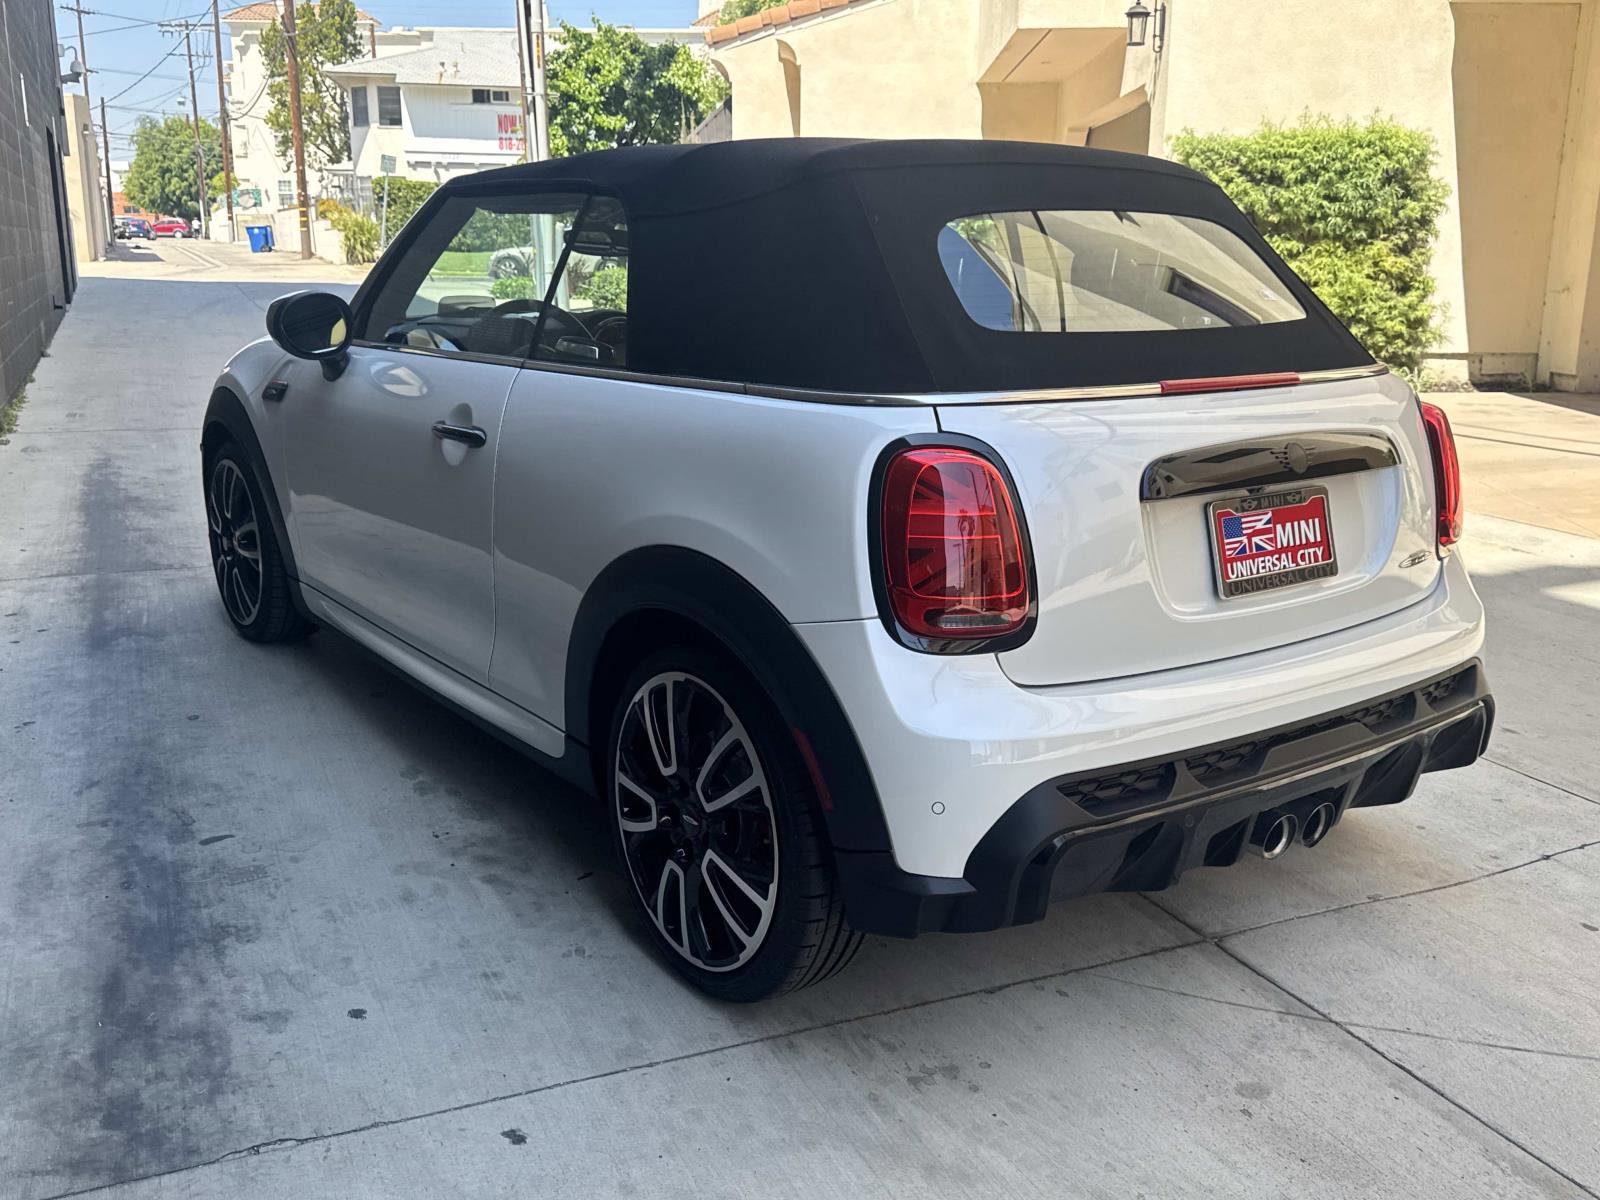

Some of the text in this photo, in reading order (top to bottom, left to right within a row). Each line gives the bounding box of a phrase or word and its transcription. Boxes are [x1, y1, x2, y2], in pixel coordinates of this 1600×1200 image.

[1261, 496, 1285, 508] MINI
[1276, 517, 1322, 549] MINI
[1227, 546, 1324, 579] UNIVERSAL CITY
[1230, 563, 1334, 595] UNIVERSAL CITY
